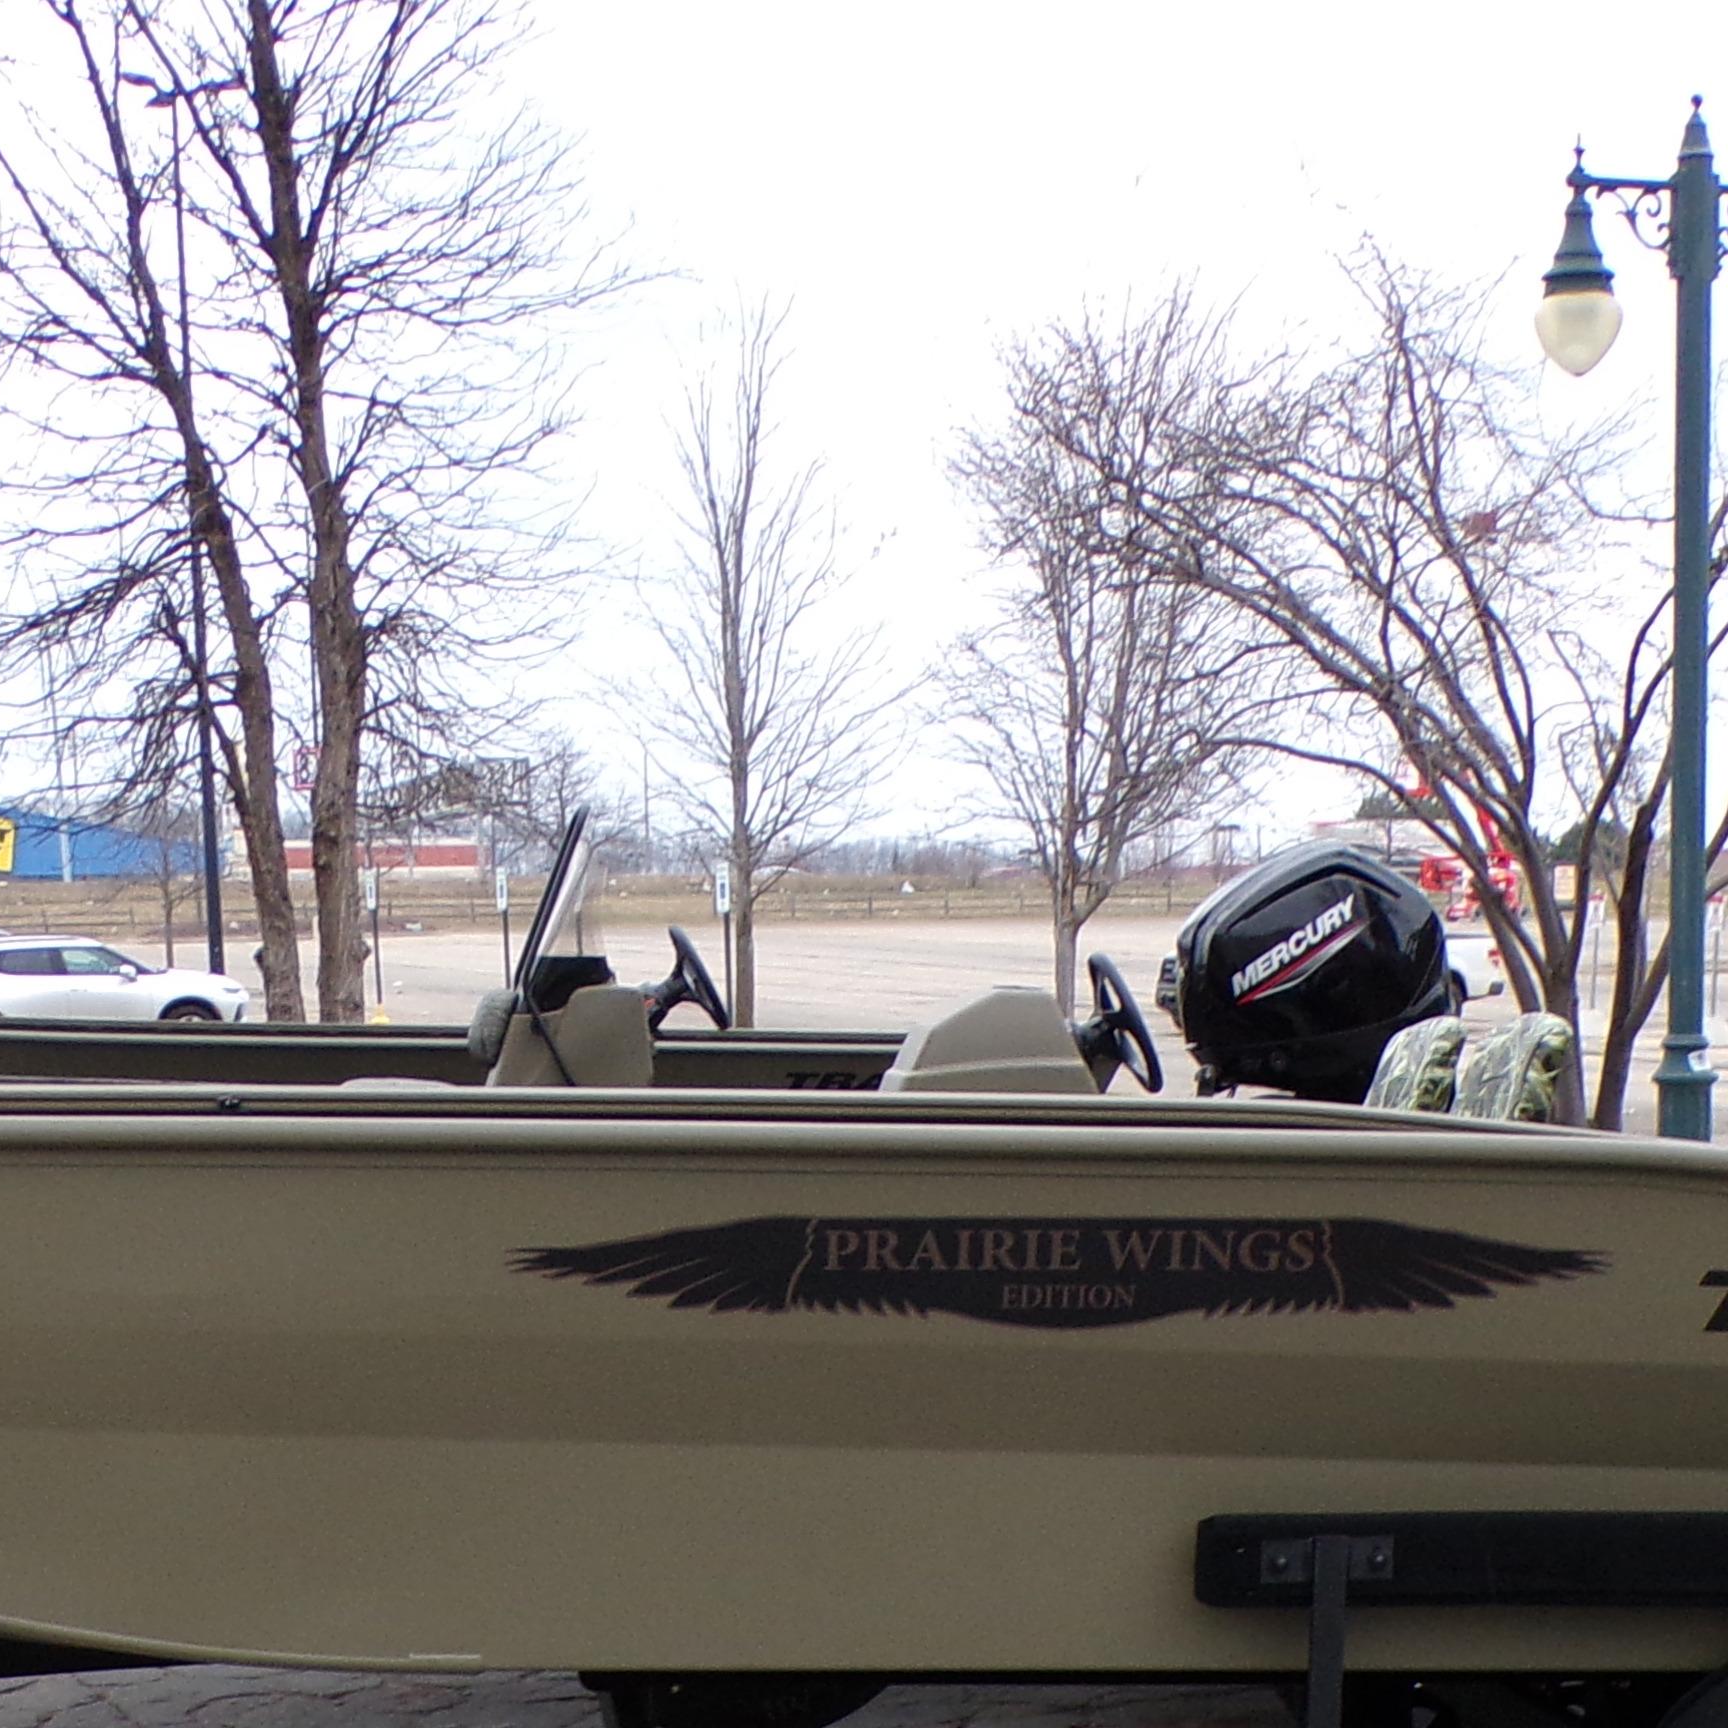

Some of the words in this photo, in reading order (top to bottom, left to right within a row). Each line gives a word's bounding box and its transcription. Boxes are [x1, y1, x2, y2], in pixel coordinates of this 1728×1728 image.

[1231, 893, 1354, 998] MERCURY
[823, 1229, 1082, 1272] PRAIRIE
[1103, 1229, 1317, 1272] WINGS
[1001, 1284, 1137, 1310] EDITION
